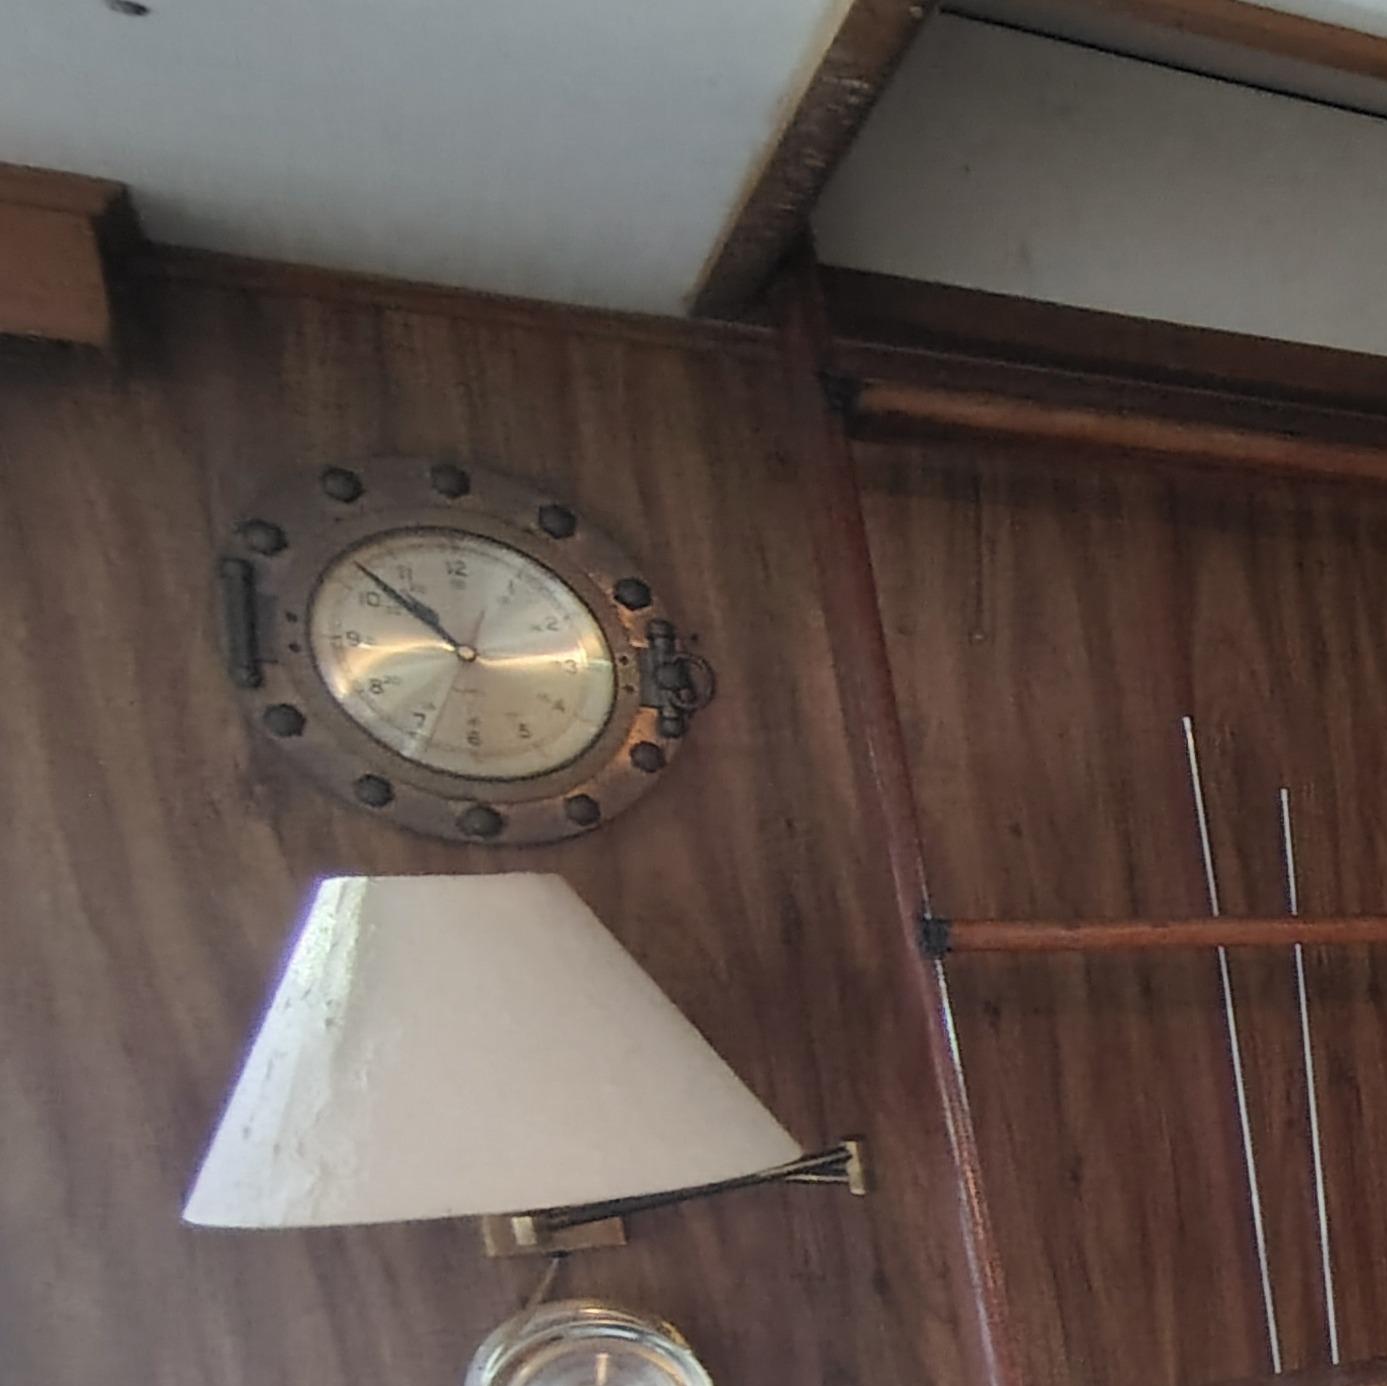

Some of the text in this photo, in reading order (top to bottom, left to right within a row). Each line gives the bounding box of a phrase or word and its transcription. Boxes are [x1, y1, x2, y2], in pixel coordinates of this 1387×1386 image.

[445, 559, 468, 577] 12
[360, 591, 382, 608] 10
[544, 615, 560, 632] 2
[346, 631, 361, 647] 9
[563, 659, 577, 675] 3
[369, 678, 384, 695] 8
[413, 711, 427, 728] 7
[466, 730, 482, 748] 6
[518, 723, 532, 740] 5
